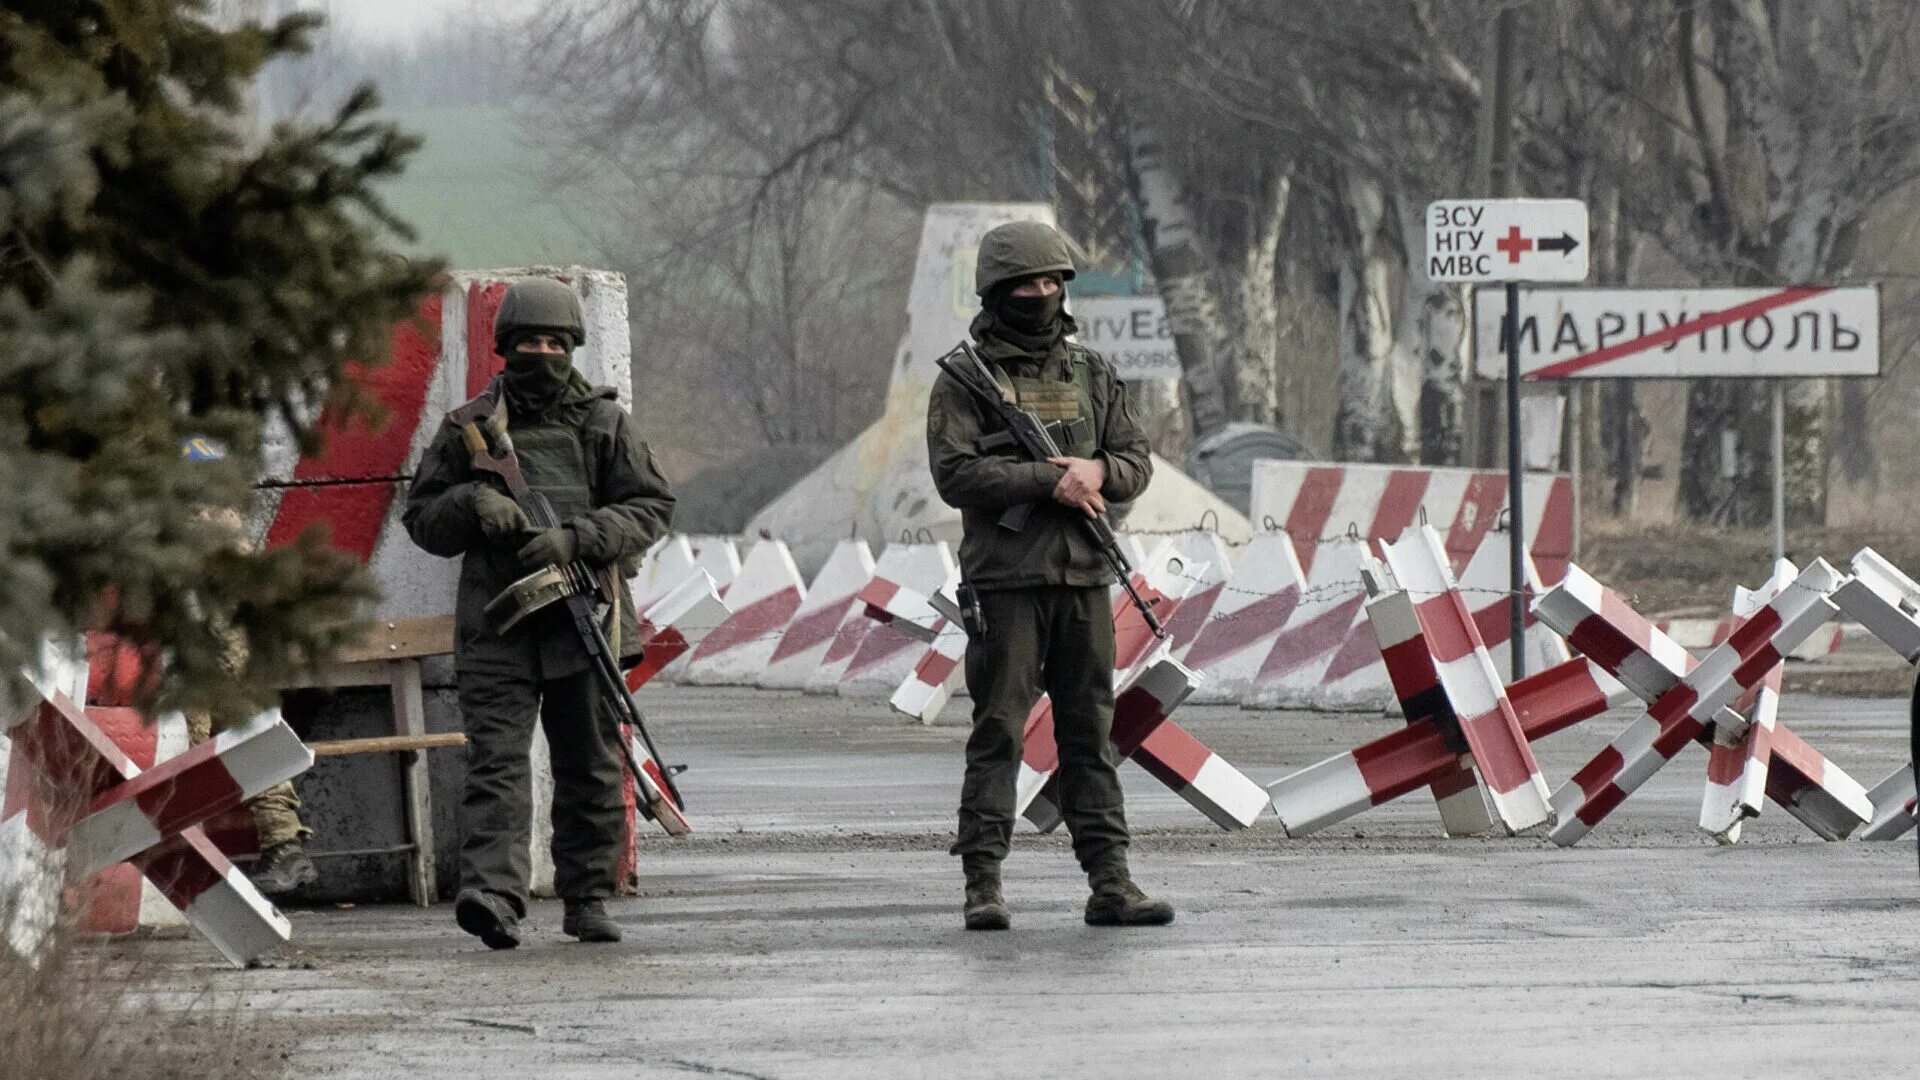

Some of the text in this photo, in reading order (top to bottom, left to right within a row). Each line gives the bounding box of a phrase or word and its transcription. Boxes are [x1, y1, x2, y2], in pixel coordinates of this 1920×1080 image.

[1434, 206, 1484, 227] ЗСУ
[1435, 231, 1484, 251] НГУ
[1430, 255, 1491, 276] МВС
[1498, 310, 1861, 354] МАРІУПОЛЬ
